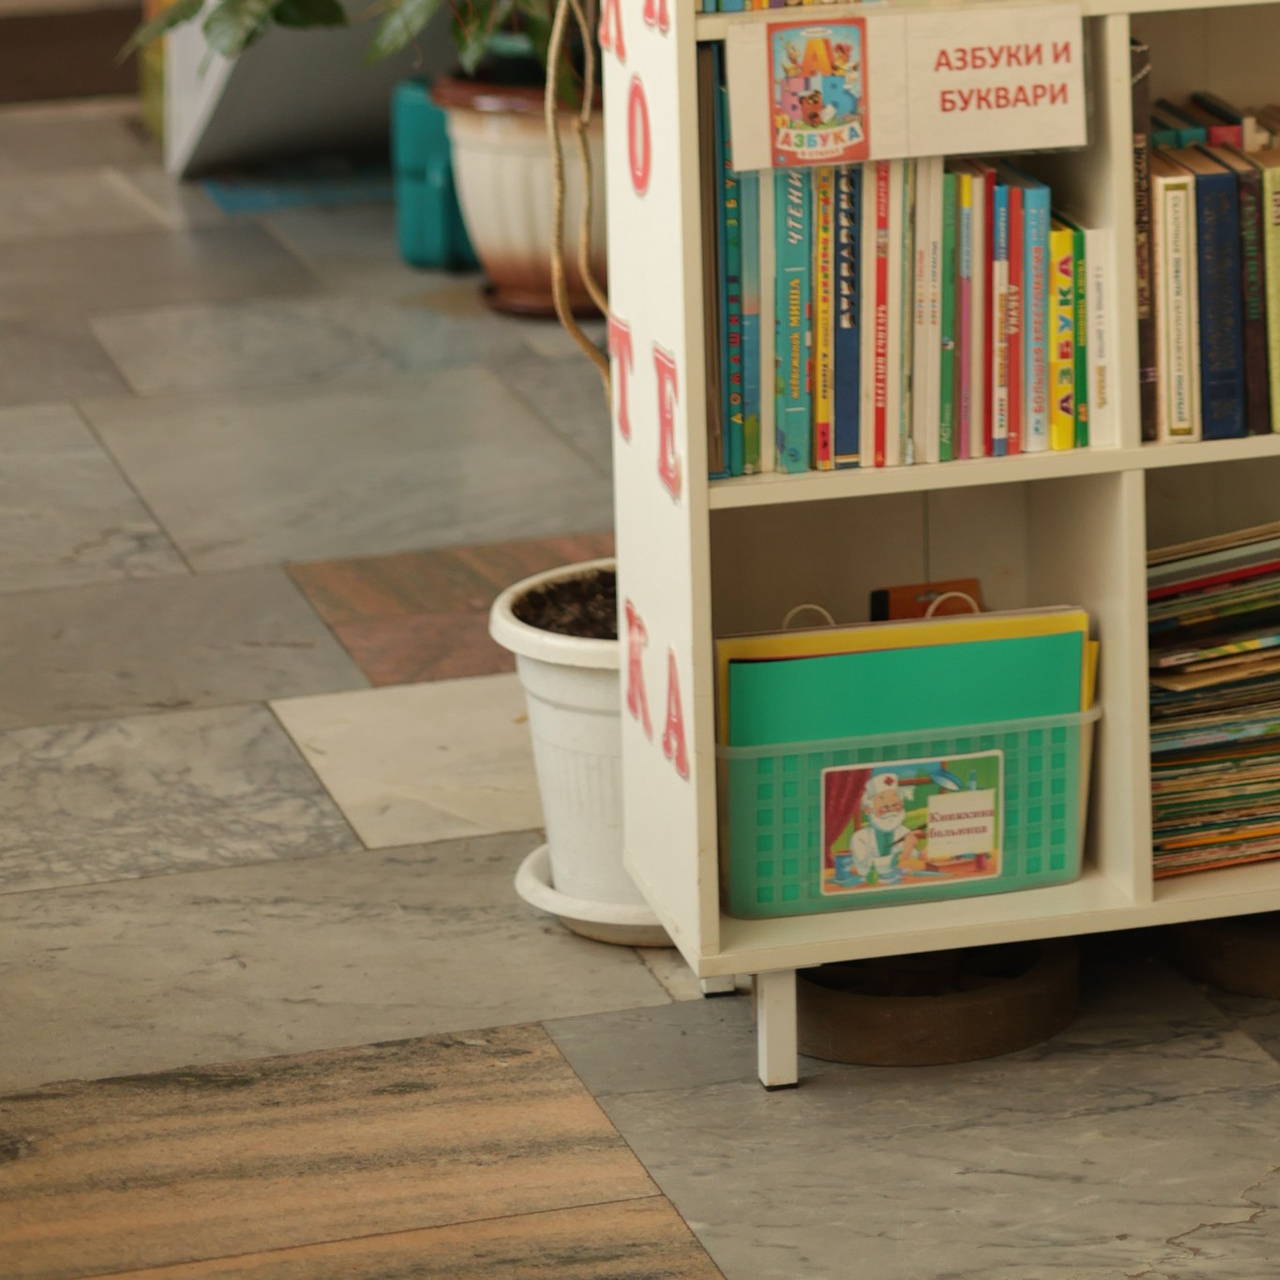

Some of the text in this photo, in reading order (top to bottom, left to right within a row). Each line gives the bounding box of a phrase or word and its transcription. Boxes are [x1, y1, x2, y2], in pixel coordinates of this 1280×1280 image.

[934, 41, 1072, 73] АЗБУКИ И
[940, 84, 1068, 113] БУКВАРИ
[777, 124, 863, 149] АЗБУКА
[787, 169, 804, 246] ЧТЕНИ
[1172, 196, 1181, 254] СКАЗОЧНЫЕ
[1173, 256, 1182, 297] ПОВЕСТИ
[789, 278, 801, 327] МИША
[1008, 285, 1019, 334] АЗБУКА
[1031, 245, 1045, 414] БОЛЬШАЯ ХРЕСТОМАТИЯ
[1057, 255, 1073, 416] АЗБУКА
[1176, 375, 1188, 422] ПИСАТЕЛЕЙ
